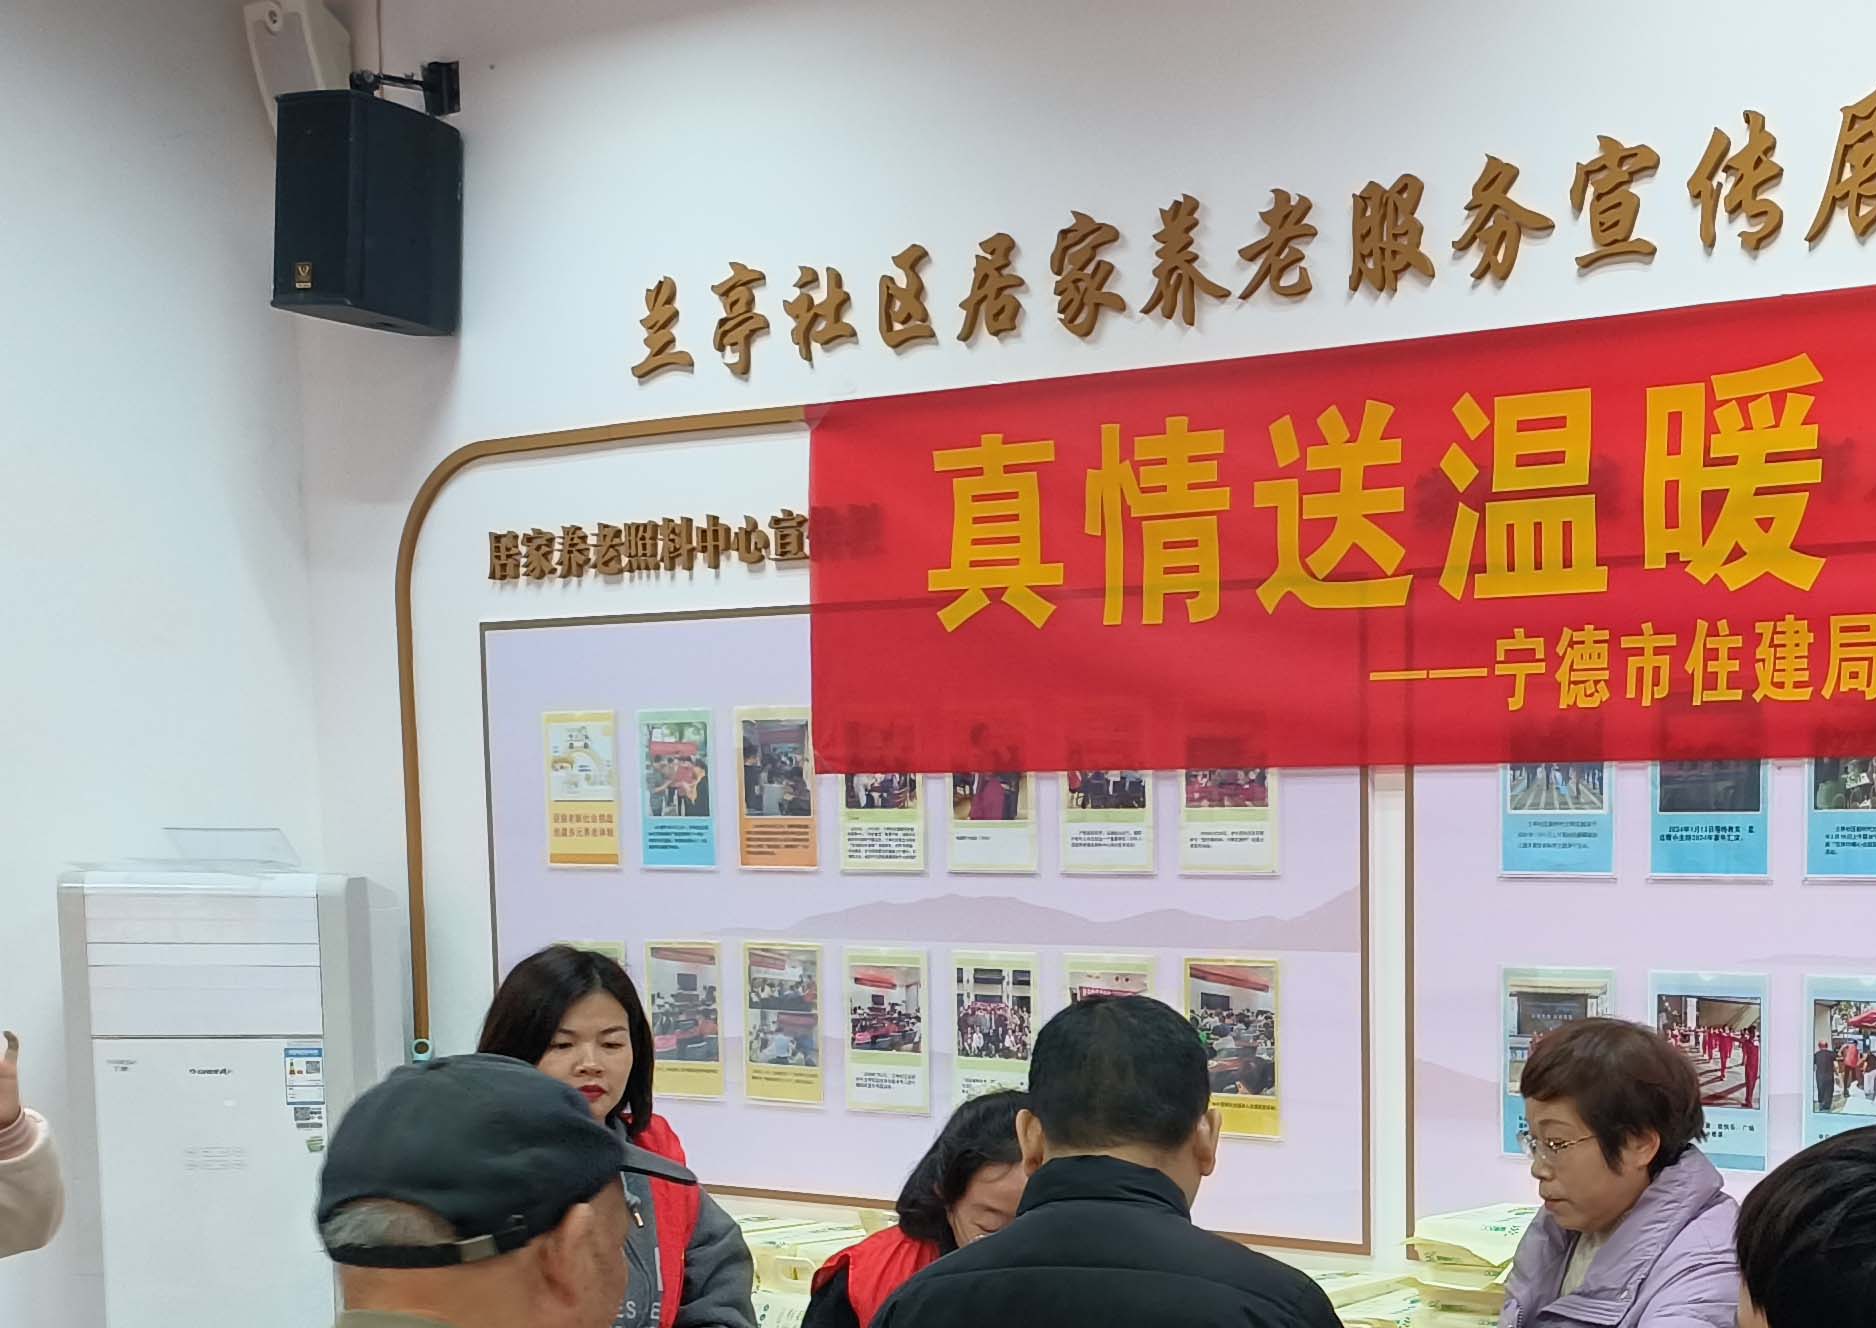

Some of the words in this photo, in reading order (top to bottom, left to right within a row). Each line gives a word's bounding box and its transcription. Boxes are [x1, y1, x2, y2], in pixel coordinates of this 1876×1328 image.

[487, 505, 882, 582] 居家养老照料中心宣
[927, 378, 1824, 633] 真情送温暖
